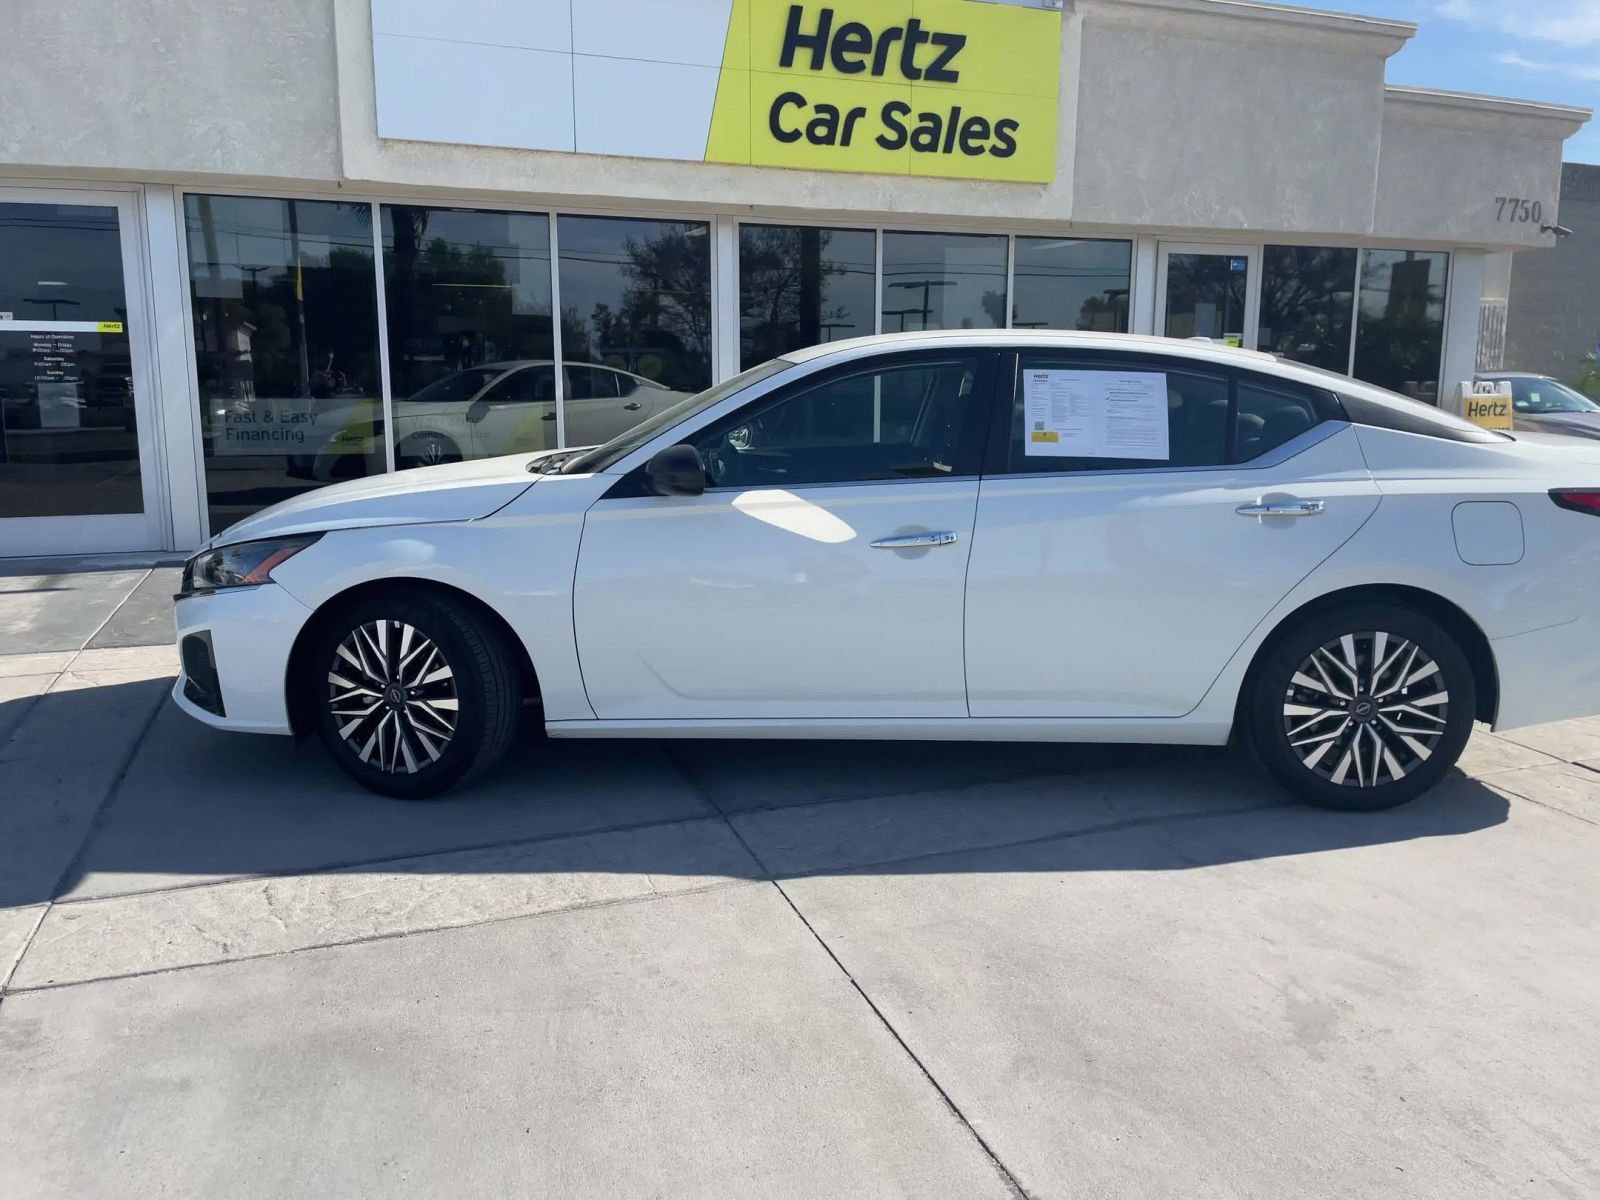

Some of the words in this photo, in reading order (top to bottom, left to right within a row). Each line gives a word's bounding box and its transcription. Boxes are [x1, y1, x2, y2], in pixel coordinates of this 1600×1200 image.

[779, 5, 966, 83] Hertz
[769, 91, 866, 146] Car
[876, 101, 1020, 157] Sales
[1495, 197, 1542, 223] 7750
[224, 409, 262, 424] Fast
[263, 410, 274, 424] &
[280, 409, 318, 426] Easy
[1468, 401, 1507, 417] Hertz
[225, 427, 304, 443] Financing
